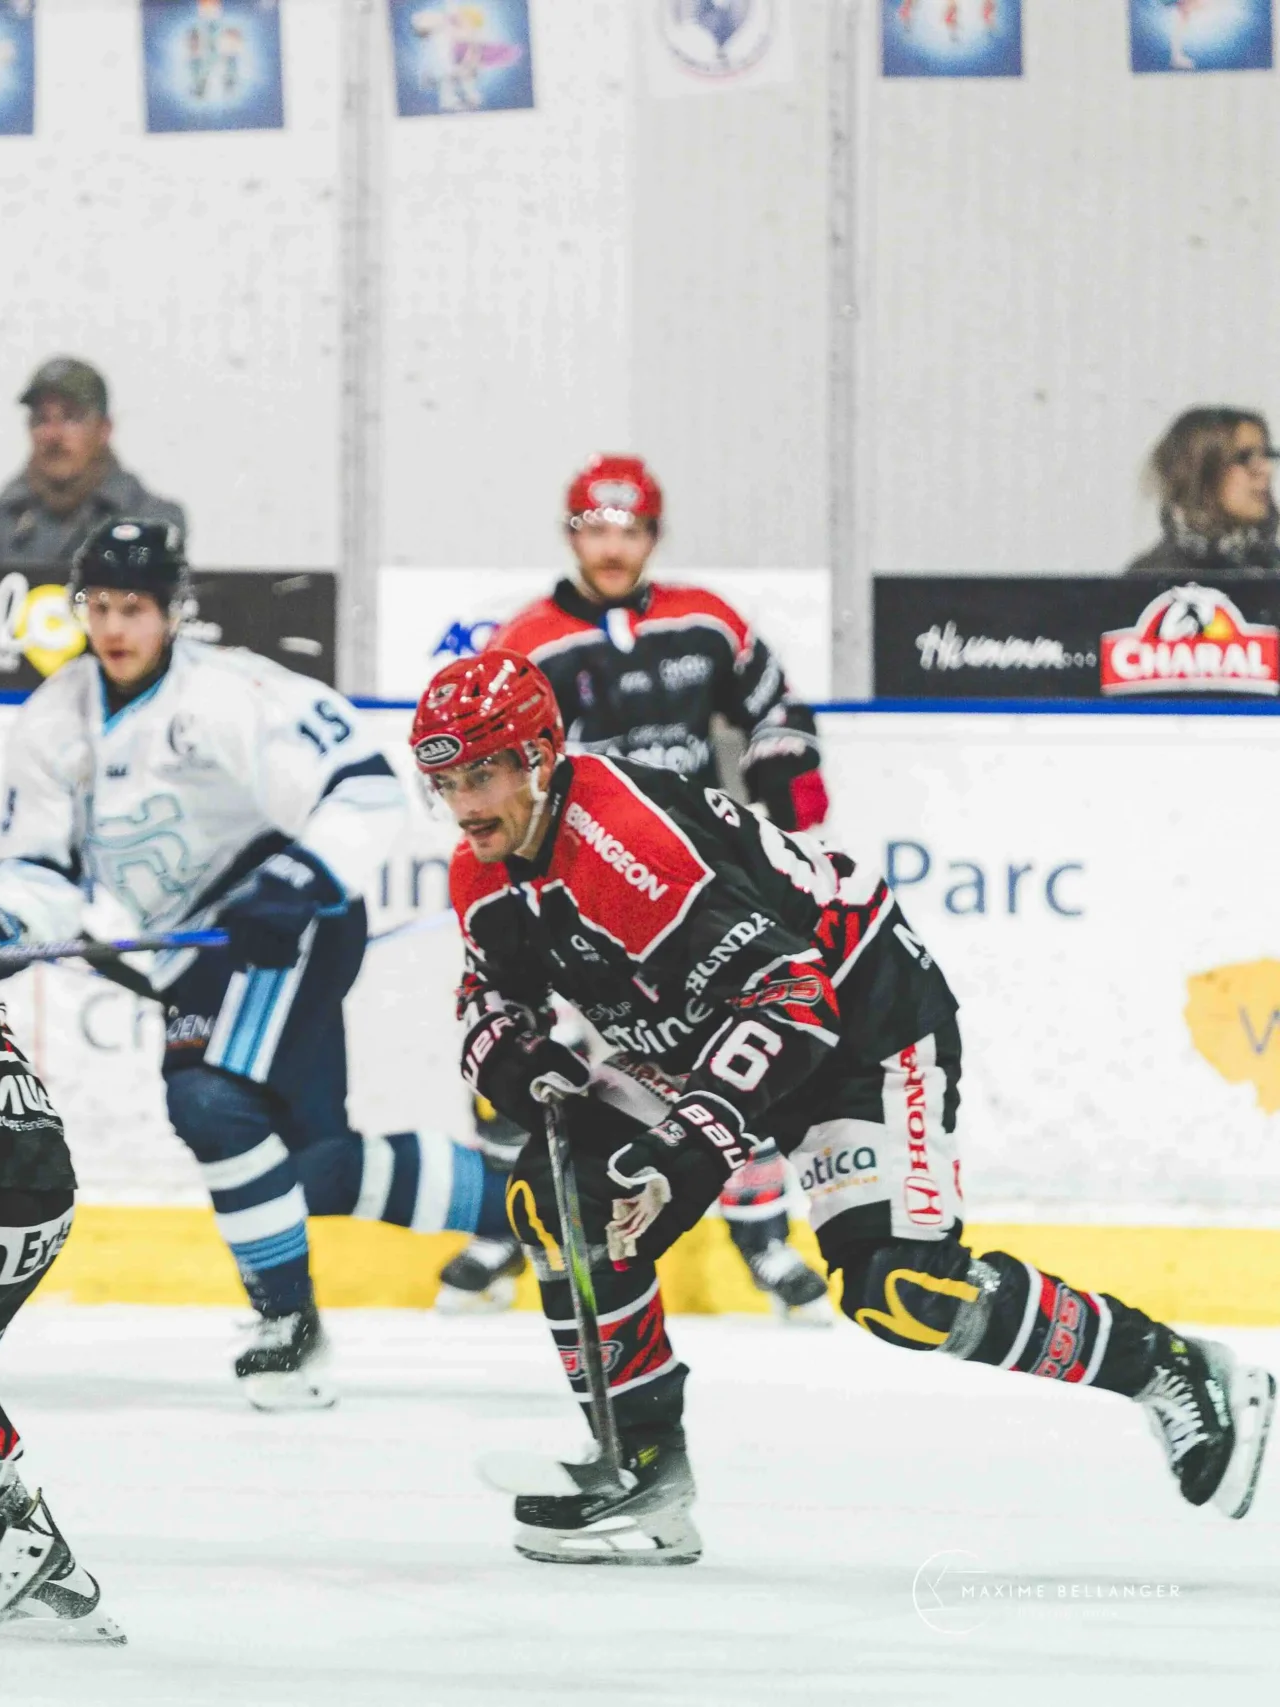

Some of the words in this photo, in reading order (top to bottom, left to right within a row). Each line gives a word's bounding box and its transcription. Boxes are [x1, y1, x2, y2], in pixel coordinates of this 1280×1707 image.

[1111, 638, 1270, 680] CHARAL
[565, 802, 669, 901] BRANGEON
[885, 840, 1086, 917] Parc
[709, 1019, 783, 1092] 6
